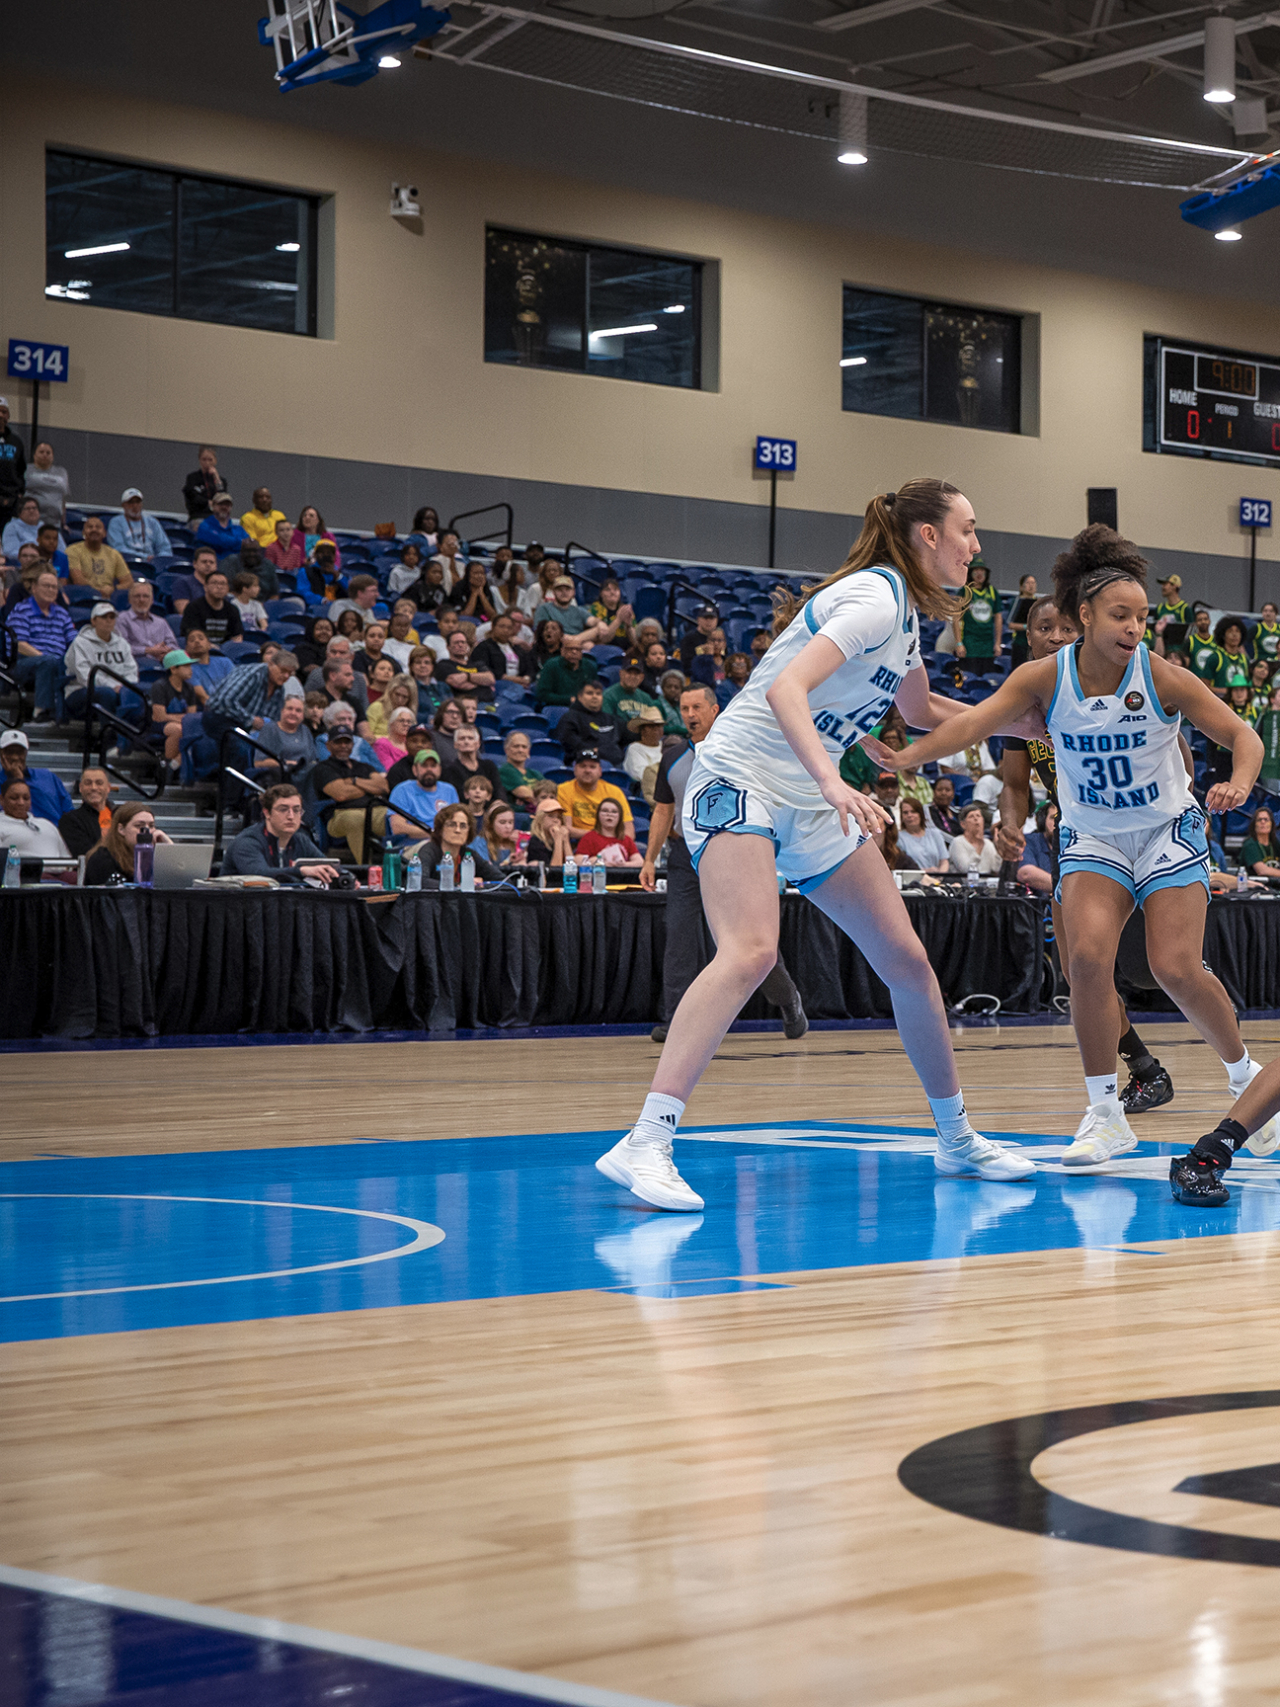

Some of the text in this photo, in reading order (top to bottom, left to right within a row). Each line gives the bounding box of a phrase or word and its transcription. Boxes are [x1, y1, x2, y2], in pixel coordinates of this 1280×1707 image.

[13, 345, 63, 375] 314
[1212, 361, 1256, 395] 9:00
[1169, 388, 1198, 406] HOME
[1214, 403, 1239, 417] PERIOD
[1187, 410, 1199, 439] 0
[759, 441, 794, 466] 313
[1242, 501, 1270, 523] 312
[1117, 714, 1147, 723] A10
[1060, 730, 1148, 753] RHODE
[1081, 755, 1134, 791] 30
[1078, 781, 1161, 810] ISLAND
